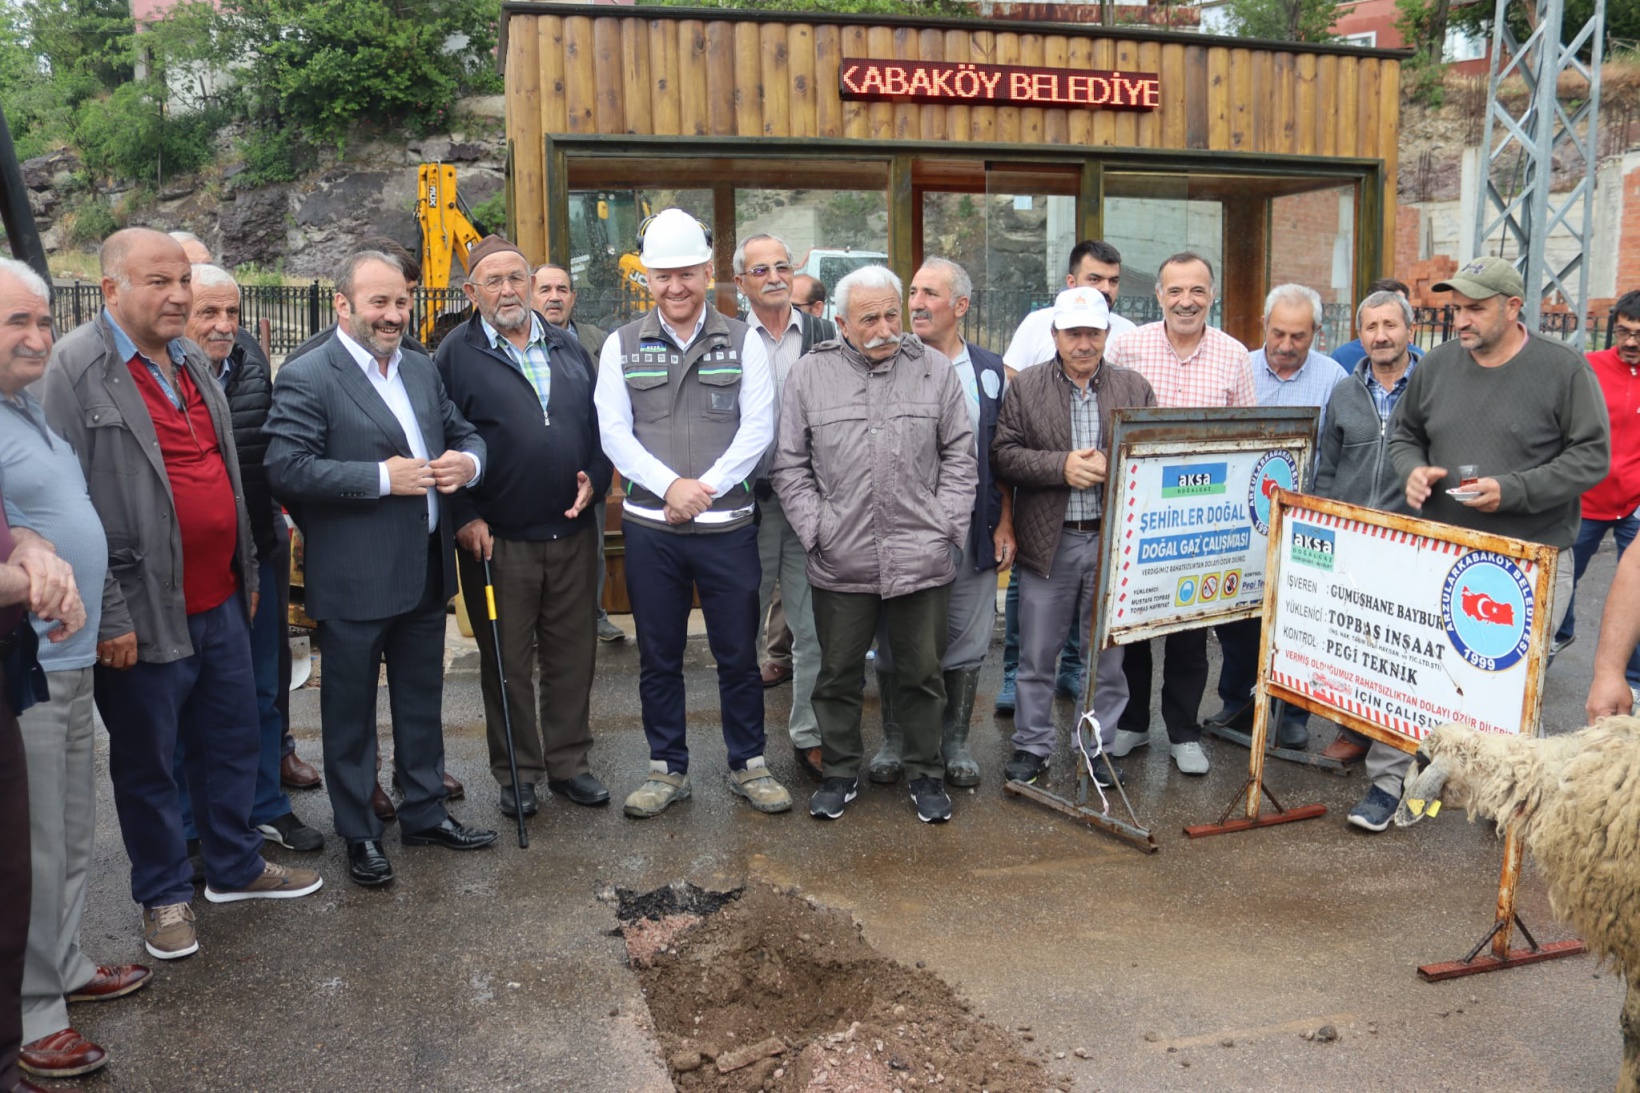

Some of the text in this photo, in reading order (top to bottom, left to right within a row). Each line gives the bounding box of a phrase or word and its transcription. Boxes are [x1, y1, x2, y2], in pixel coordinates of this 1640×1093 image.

[1010, 72, 1159, 107] BELEDİYE
[629, 271, 648, 288] JC
[1179, 473, 1211, 487] aksa
[1140, 501, 1245, 533] ŞEHİRLER DOĞAL
[1255, 520, 1269, 535] 199
[1142, 532, 1249, 559] DOĞAL GAZ ÇALIŞMASI
[1294, 533, 1333, 554] aksa
[1330, 584, 1394, 616] GÜMÜŞHANE
[1397, 604, 1443, 631] BAYBUR
[1385, 624, 1445, 660] İNŞAAT
[1326, 639, 1358, 663] PEGİ
[1362, 652, 1418, 686] TEKNİK
[1463, 648, 1496, 671] 1999
[1355, 675, 1417, 706] RAHATSIZLIKTAN
[1420, 699, 1450, 719] DOLAYI
[1355, 687, 1443, 728] İÇİN ÇALIŞIY
